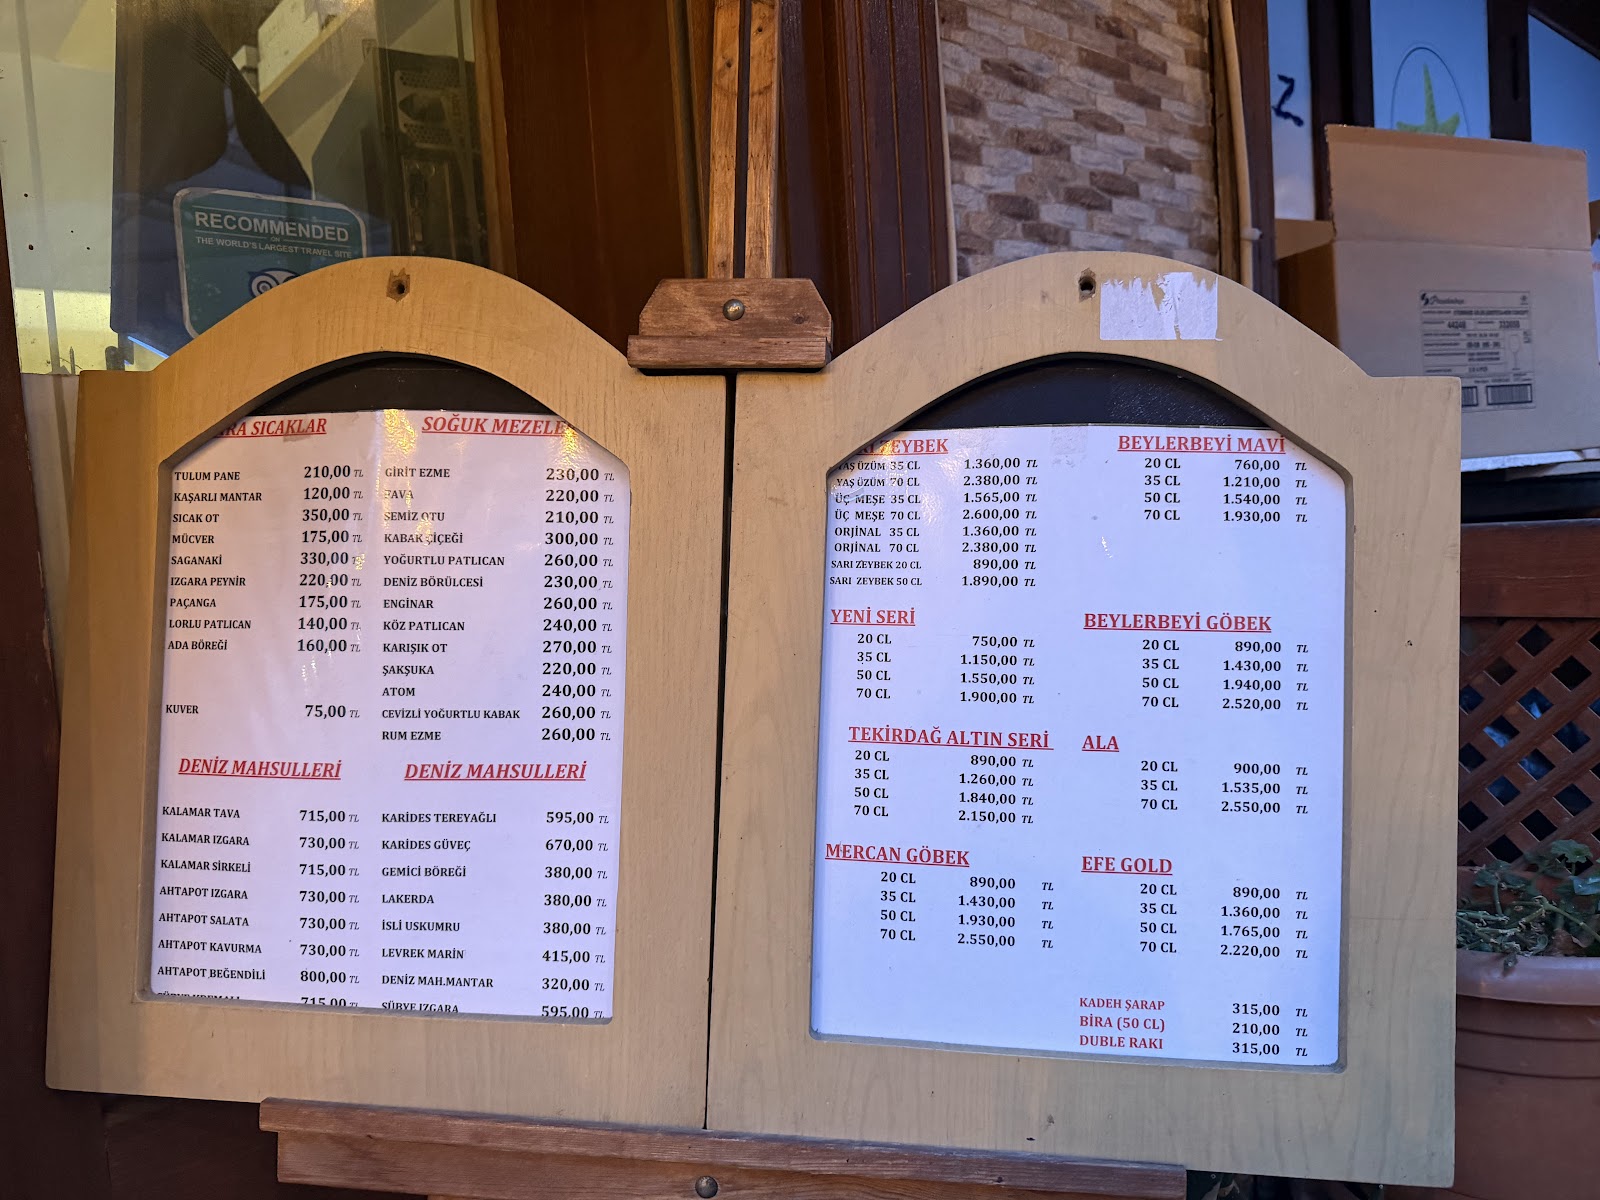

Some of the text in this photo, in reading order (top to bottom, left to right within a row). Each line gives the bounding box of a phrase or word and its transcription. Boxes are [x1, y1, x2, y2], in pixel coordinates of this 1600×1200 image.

[195, 211, 349, 242] RECOMMENDED
[196, 236, 214, 245] THE
[259, 243, 299, 254] LARGEST
[302, 248, 333, 257] TRAVEL
[251, 418, 327, 436] SICAKLAR
[422, 413, 576, 437] SOĞUK MEZELE
[1118, 434, 1286, 454] BEYLERBEYİ MAVİ
[173, 471, 243, 481] TULUM PANE
[303, 464, 364, 480] 210,00 TL
[384, 465, 451, 478] GİRİT EZME
[857, 477, 885, 486] ÜZÜM
[889, 477, 904, 487] 70
[906, 476, 920, 487] CL
[174, 492, 262, 504] KAŞARLI MANTAR
[1223, 493, 1308, 507] 1.540,00 TL
[173, 513, 220, 523] SICAK OT
[384, 509, 445, 522] SEMİZ OTU
[834, 510, 921, 523] ÜÇ MEŞE 70 CL
[962, 508, 1038, 521] 2.600,00 TL
[1143, 509, 1181, 521] 70 CL
[172, 533, 215, 544] MÜCVER
[384, 533, 424, 544] KABAK
[834, 525, 920, 539] ORJİNAL 35 CL
[544, 531, 614, 548] 300,00 TL
[171, 553, 223, 566] SAGANAKİ
[383, 553, 505, 566] YOĞURTLU PATLICAN
[831, 559, 922, 570] SARI ZEYBEK 20 CL
[170, 575, 246, 587] IZGARA PEYNİR
[383, 575, 484, 588] DENİZ BÖRÜLCESİ
[829, 576, 923, 586] SARI ZEYBEK 50 CL
[170, 598, 217, 610] PAÇANGA
[299, 594, 362, 610] 175,00 TL
[383, 597, 435, 609] ENGİNAR
[831, 607, 916, 626] YENİ SERİ
[1084, 612, 1272, 632] BEYLERBEYİ GÖBEK
[169, 619, 252, 630] LORLU PATLICAN
[382, 618, 466, 632] KÖZ PATLICAN
[167, 639, 228, 651] ADA BÖREĞİ
[382, 642, 448, 655] KARIŞIK OT
[856, 651, 892, 663] 35 CL
[960, 653, 1035, 667] 1.150,00 TL
[381, 664, 435, 677] ŞAKŞUKA
[381, 686, 416, 697] ATOM
[541, 683, 612, 699] 240,00 TL
[1223, 678, 1309, 693] 1.940,00 TL
[165, 704, 199, 715] KUVER
[304, 704, 360, 720] 75,00 TL
[381, 707, 521, 719] CEVİZLİ YOĞURTLU KABAK
[381, 730, 442, 741] RUM EZME
[848, 725, 1050, 748] TEKİRDAĞ ALTIN SERİ
[1081, 734, 1120, 753] ALA
[178, 756, 342, 780] DENİZ MAHSULLERİ
[404, 760, 587, 781] DENİZ MAHSULLERİ
[1140, 798, 1178, 811] 70 CL
[162, 806, 241, 819] KALAMAR TAVA
[381, 811, 497, 823] KARİDES TEREYAĞLI
[545, 811, 609, 826] 595,00 TL
[381, 838, 471, 853] KARİDES GÜVEÇ
[825, 843, 970, 867] MERCAN GÖBEK
[160, 859, 251, 873] KALAMAR SİRKELİ
[381, 864, 467, 878] GEMİCİ BÖREĞİ
[1081, 856, 1173, 875] EFE GOLD
[880, 871, 917, 884] 20 CL
[159, 885, 249, 900] AHTAPOT IZGARA
[381, 893, 435, 905] LAKERDA
[958, 894, 1054, 911] 1.430,00 TL
[299, 916, 360, 932] 730,00 TL
[381, 918, 461, 932] İSLİ USKUMRU
[157, 939, 263, 954] AHTAPOT KAVURMA
[381, 947, 465, 960] LEVREK MARİN
[156, 965, 267, 981] AHTAPOT BEĞENDİLİ
[381, 973, 494, 988] DENİZ MAH.MANTAR
[1079, 997, 1165, 1011] KADEH ŞARAP
[1079, 1013, 1165, 1033] BİRA (50 CL)
[1080, 1035, 1165, 1050] DUBLE RAKI
[1232, 1041, 1308, 1057] 315,00 TL
